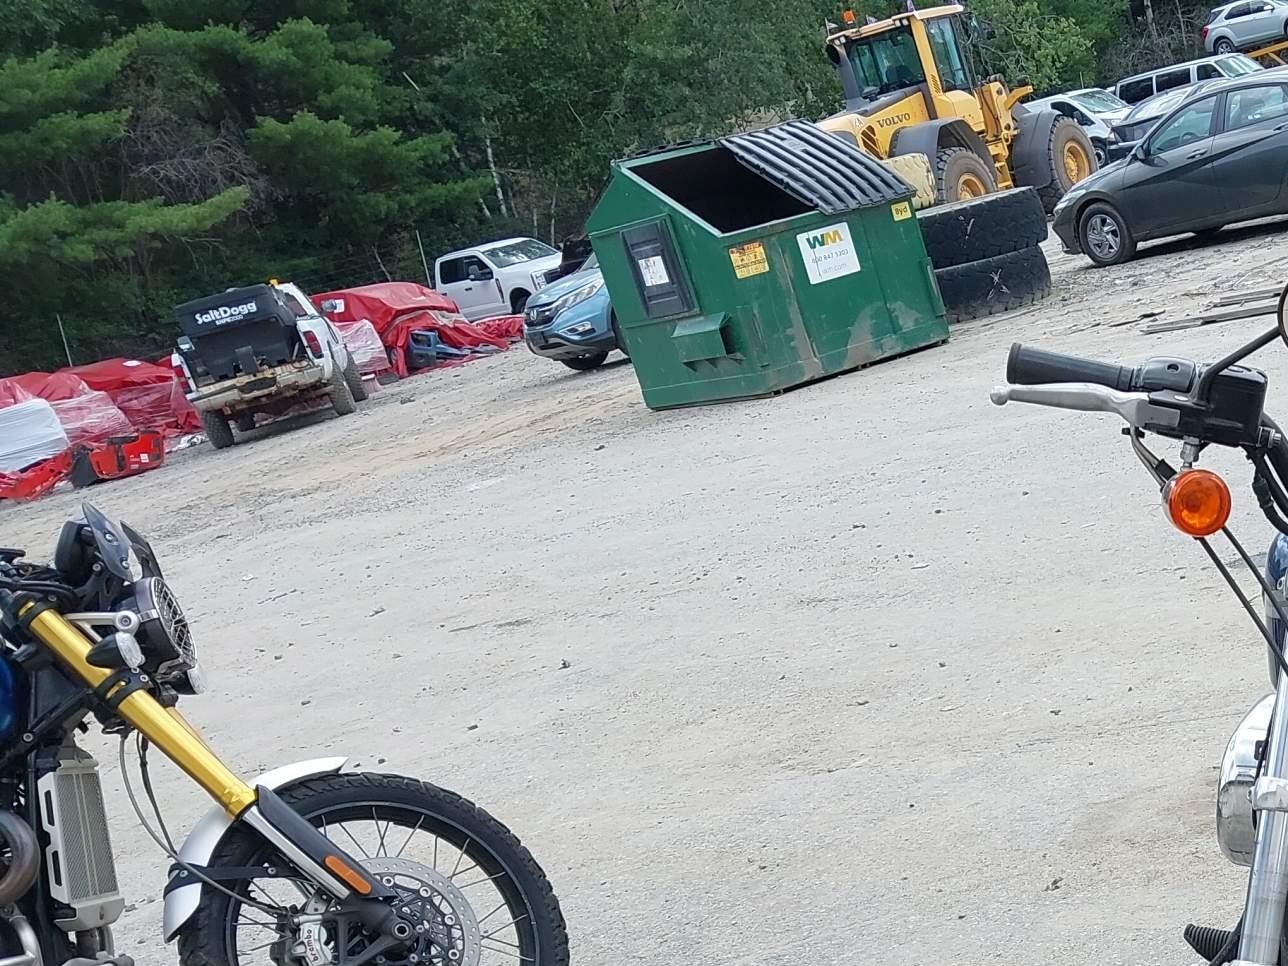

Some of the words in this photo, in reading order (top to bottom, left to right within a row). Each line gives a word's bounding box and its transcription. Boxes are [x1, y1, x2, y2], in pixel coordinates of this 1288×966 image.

[877, 113, 911, 128] VOLVO
[806, 230, 843, 250] WM
[195, 303, 257, 324] SaltDogg
[304, 929, 319, 962] brembo
